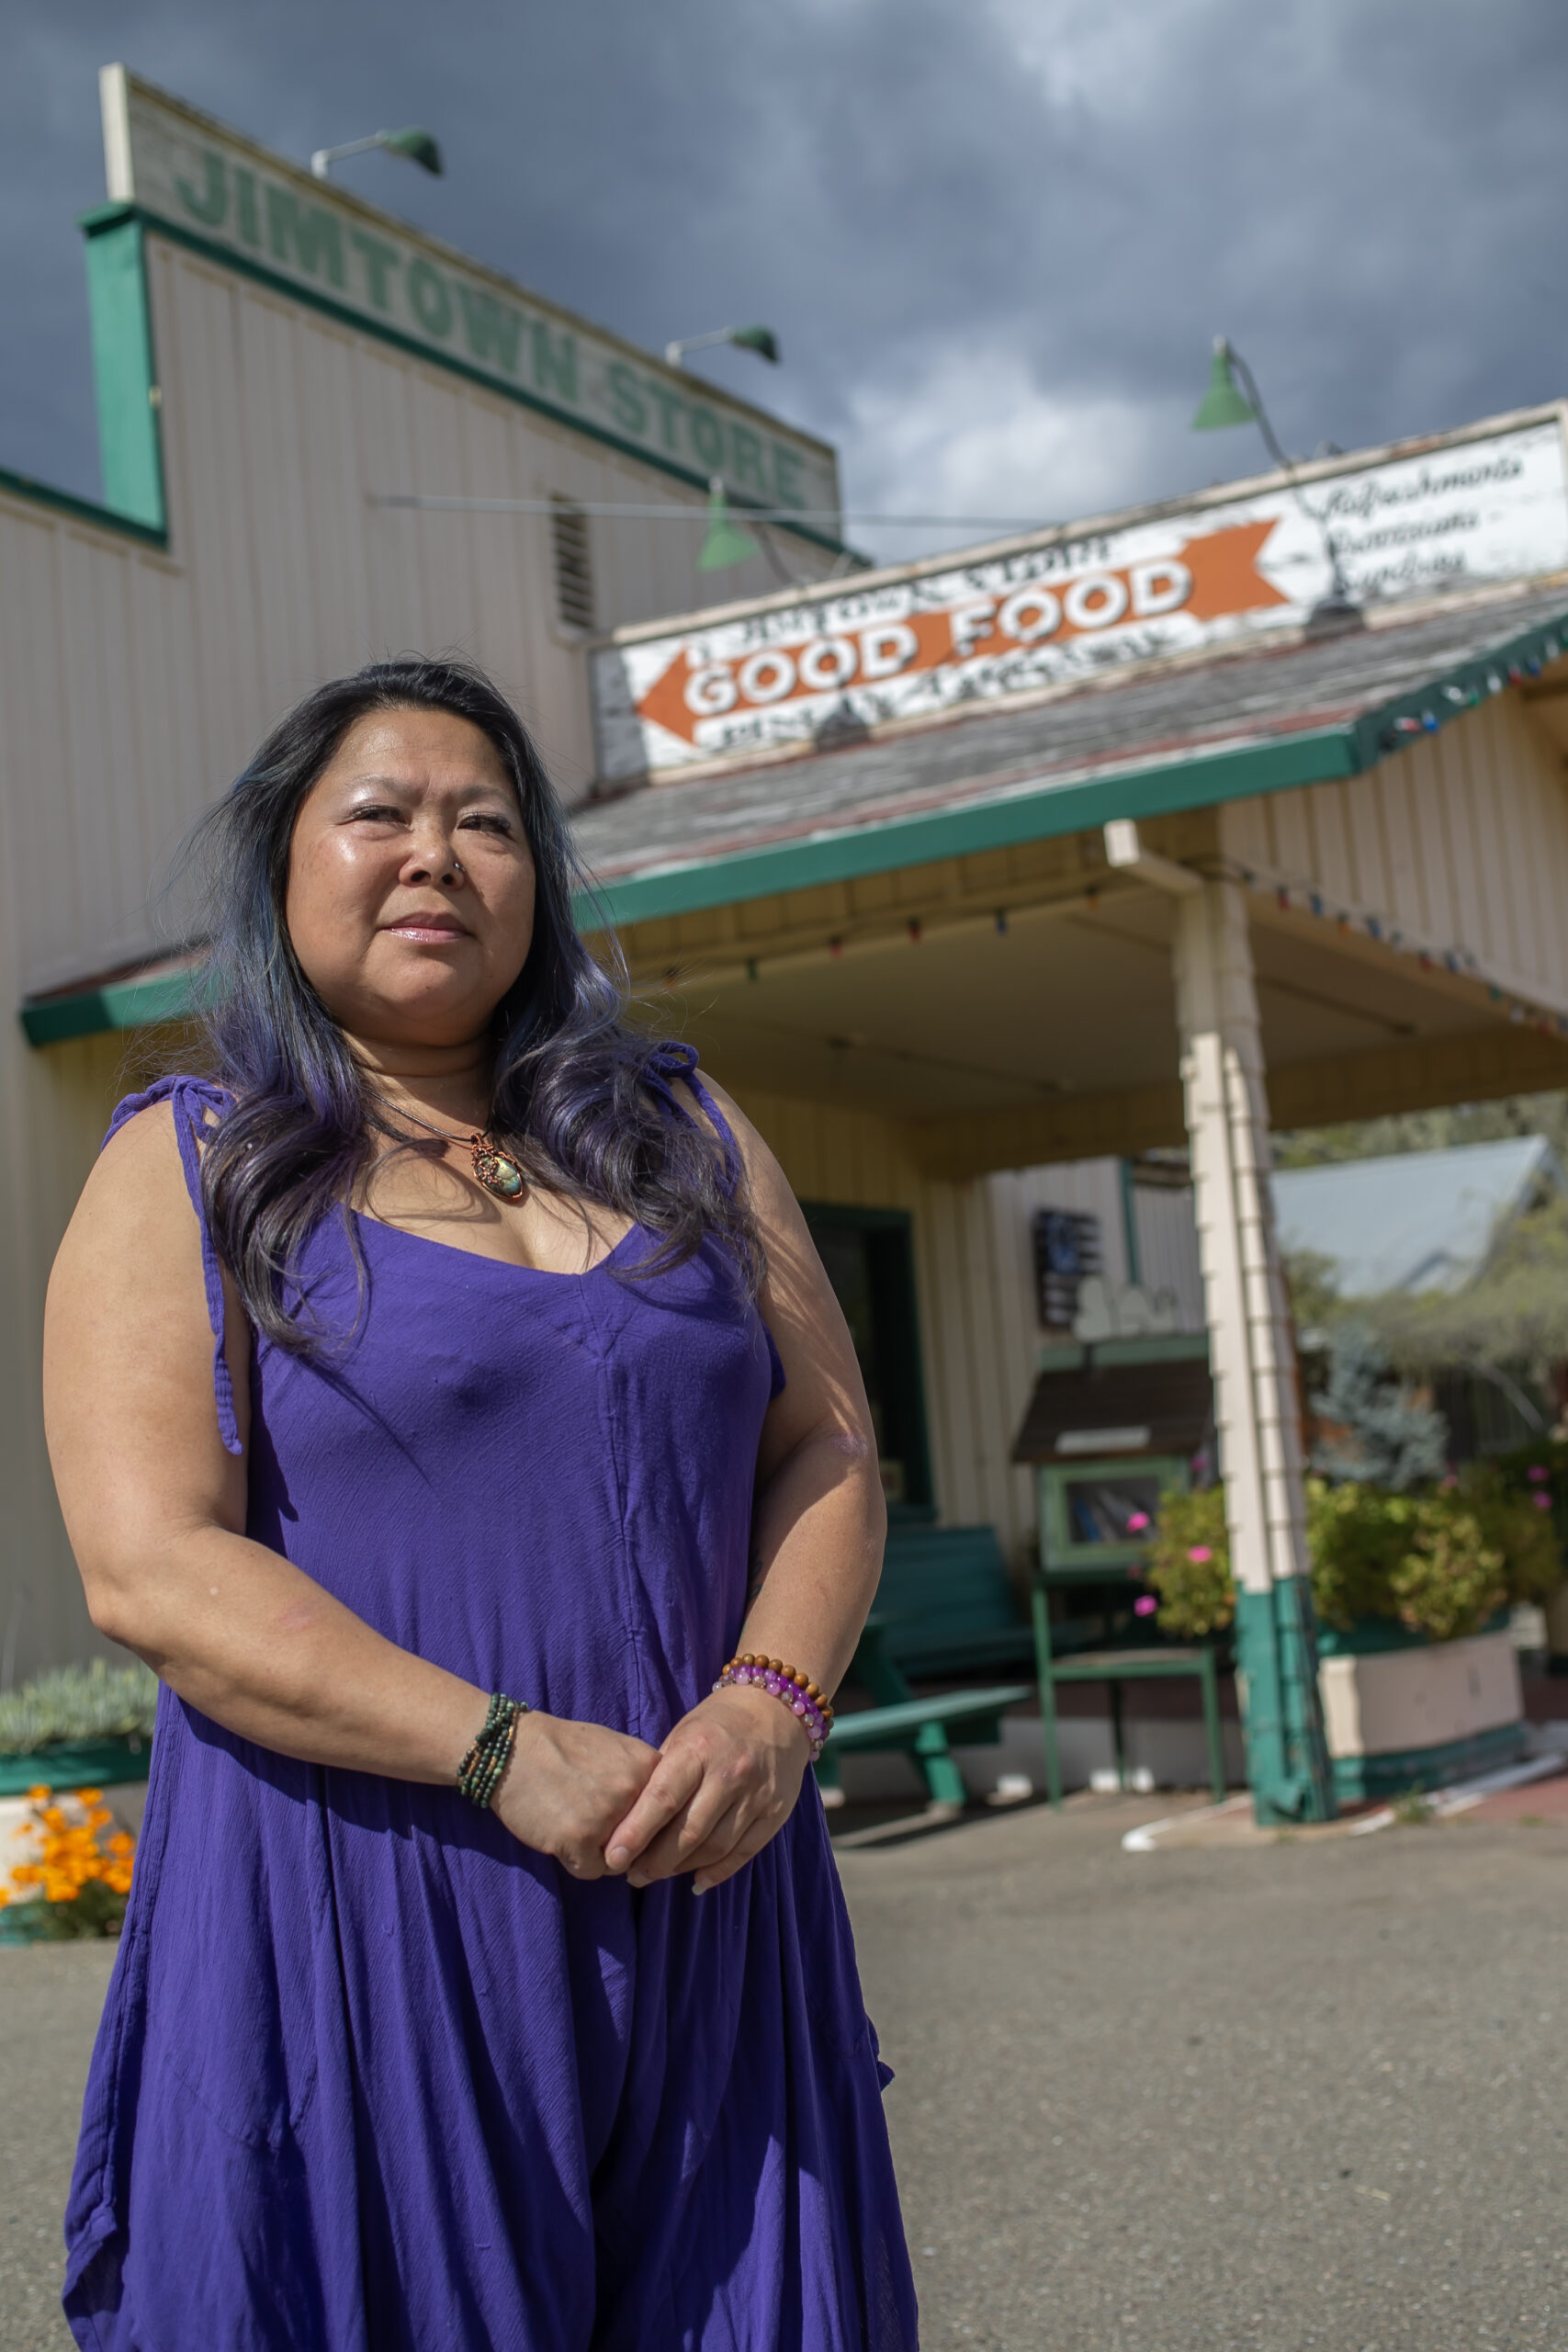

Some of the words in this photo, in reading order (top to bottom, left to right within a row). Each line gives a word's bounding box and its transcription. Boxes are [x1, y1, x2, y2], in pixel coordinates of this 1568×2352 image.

[172, 149, 580, 403] JIMTOWN
[606, 360, 809, 509] STORE
[682, 622, 919, 717] GOOD
[949, 559, 1194, 658] FOOD
